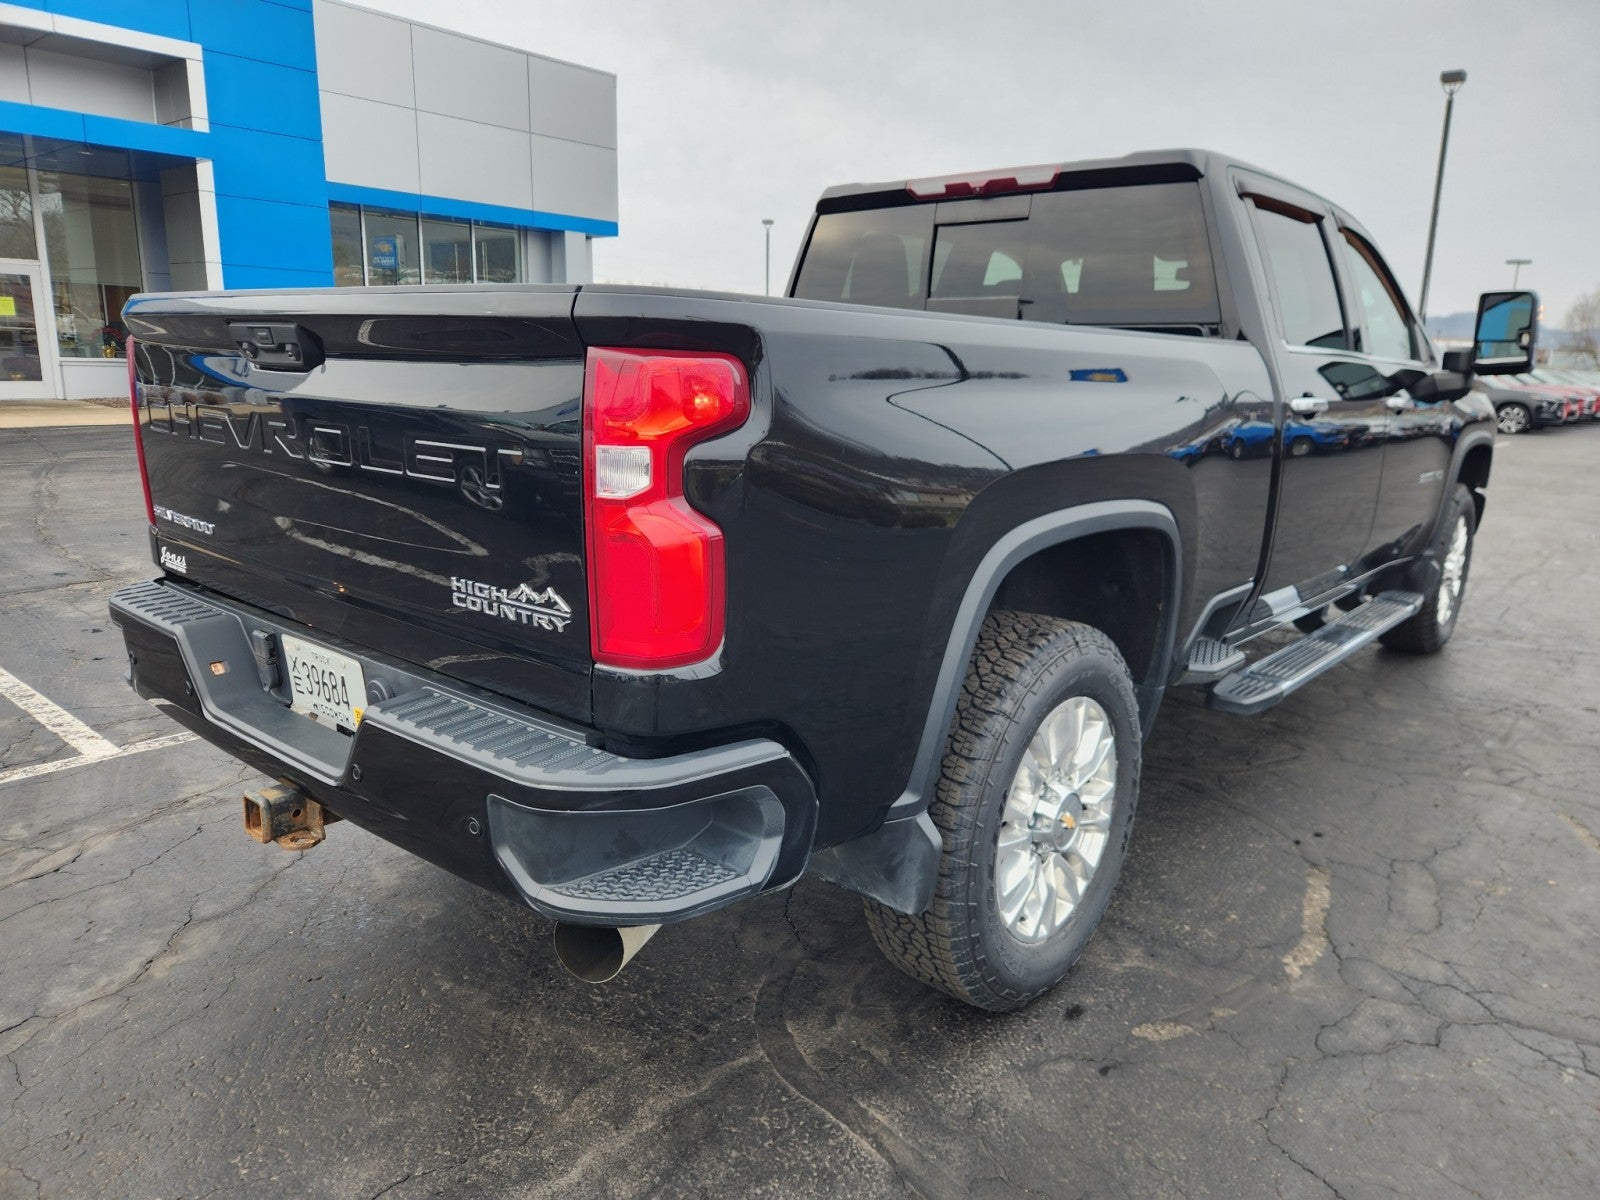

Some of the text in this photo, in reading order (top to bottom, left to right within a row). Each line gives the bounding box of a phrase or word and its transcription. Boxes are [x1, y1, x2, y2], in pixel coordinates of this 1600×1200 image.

[147, 397, 523, 490] CHEVROLET
[450, 576, 508, 602] HIGH
[452, 592, 571, 633] COUNTRY
